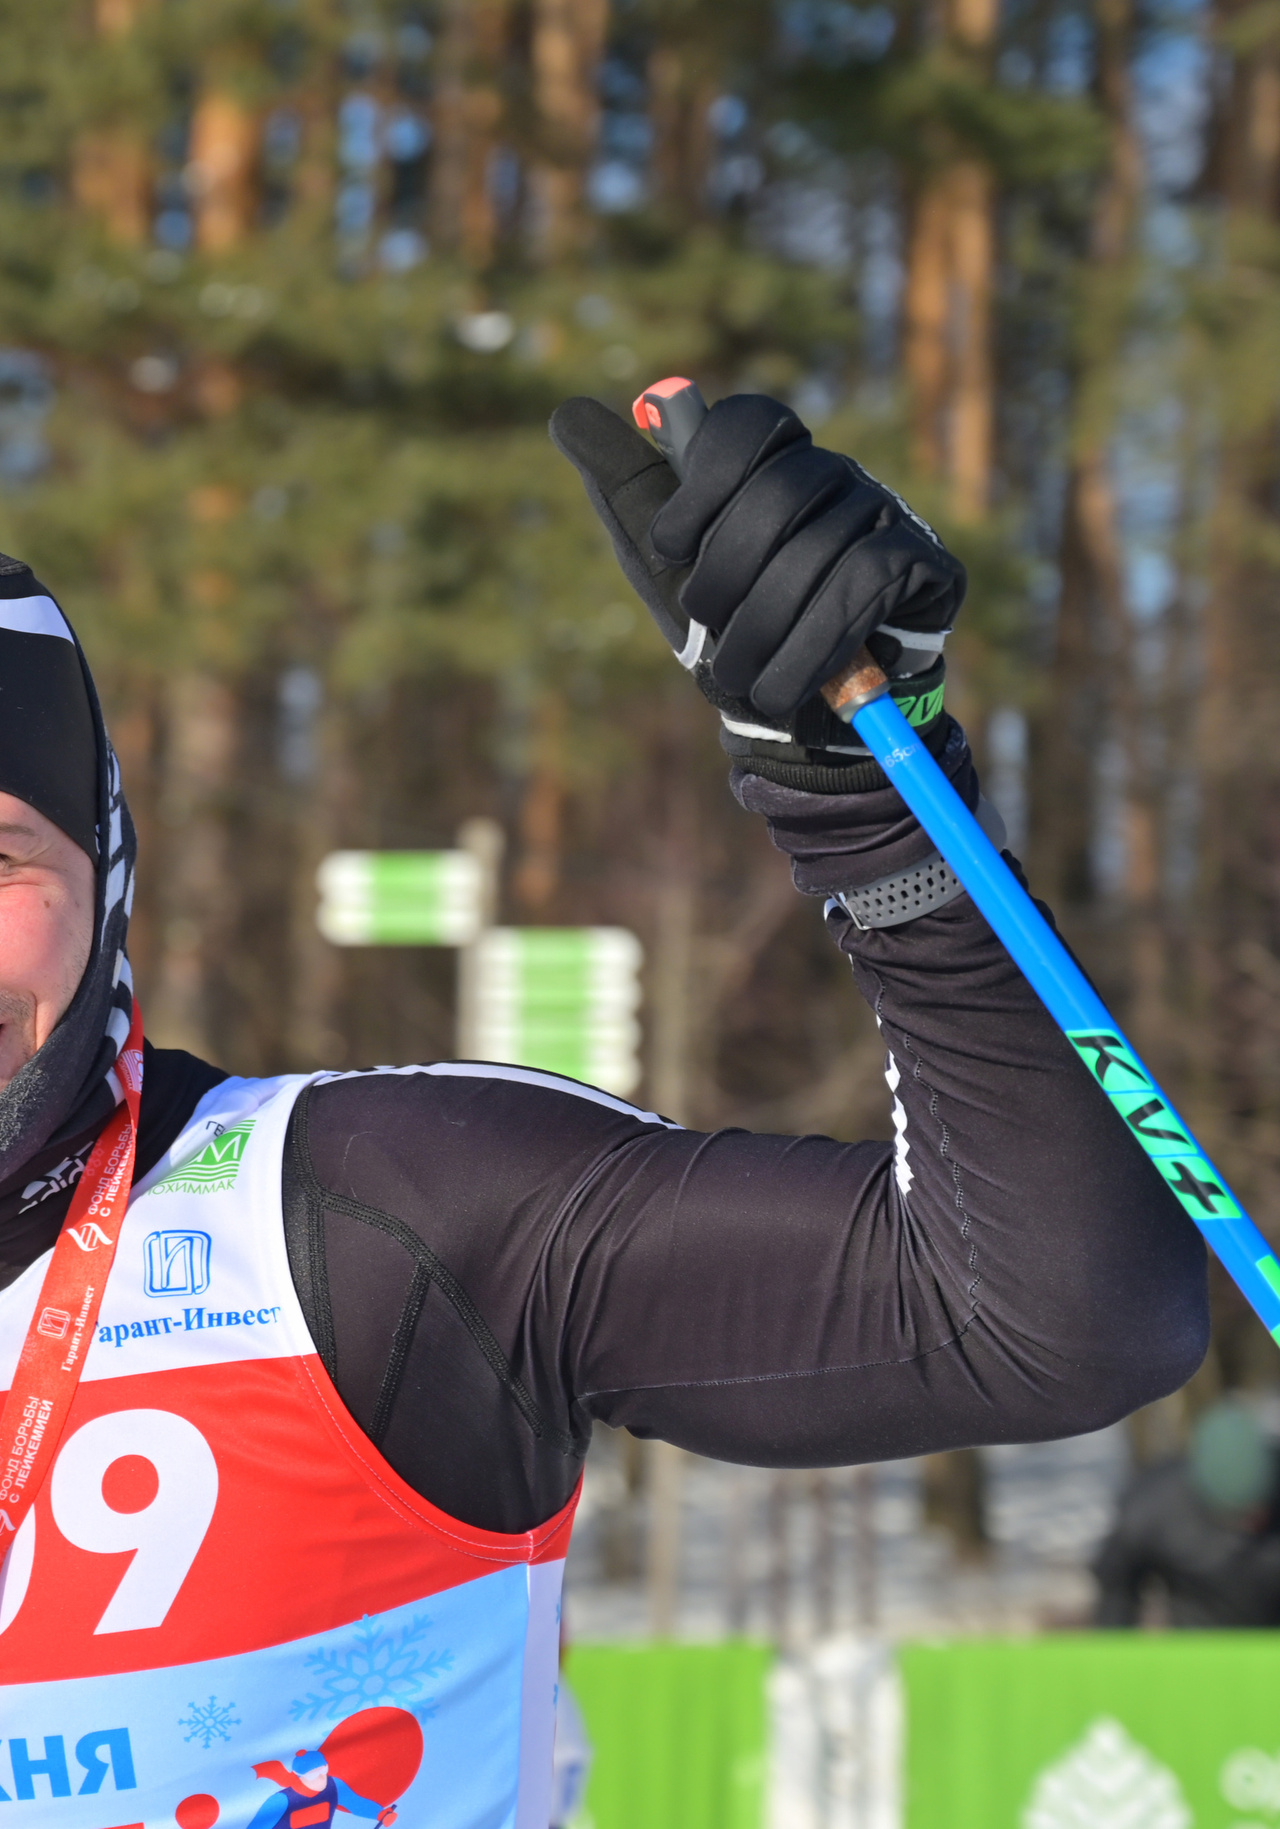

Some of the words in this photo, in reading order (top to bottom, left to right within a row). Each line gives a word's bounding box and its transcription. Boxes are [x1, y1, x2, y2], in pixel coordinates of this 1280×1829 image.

[88, 1176, 111, 1215] ФОНД
[104, 1123, 133, 1176] БОРЬБЫ
[100, 1203, 111, 1217] С
[60, 1285, 95, 1372] Гарант-Инвест
[95, 1306, 281, 1348] арант-Инвест
[9, 1493, 20, 1504] С
[18, 1399, 54, 1488] ЛЕЙКЕМИЕЙ
[12, 1396, 40, 1456] БОРЬБЫ
